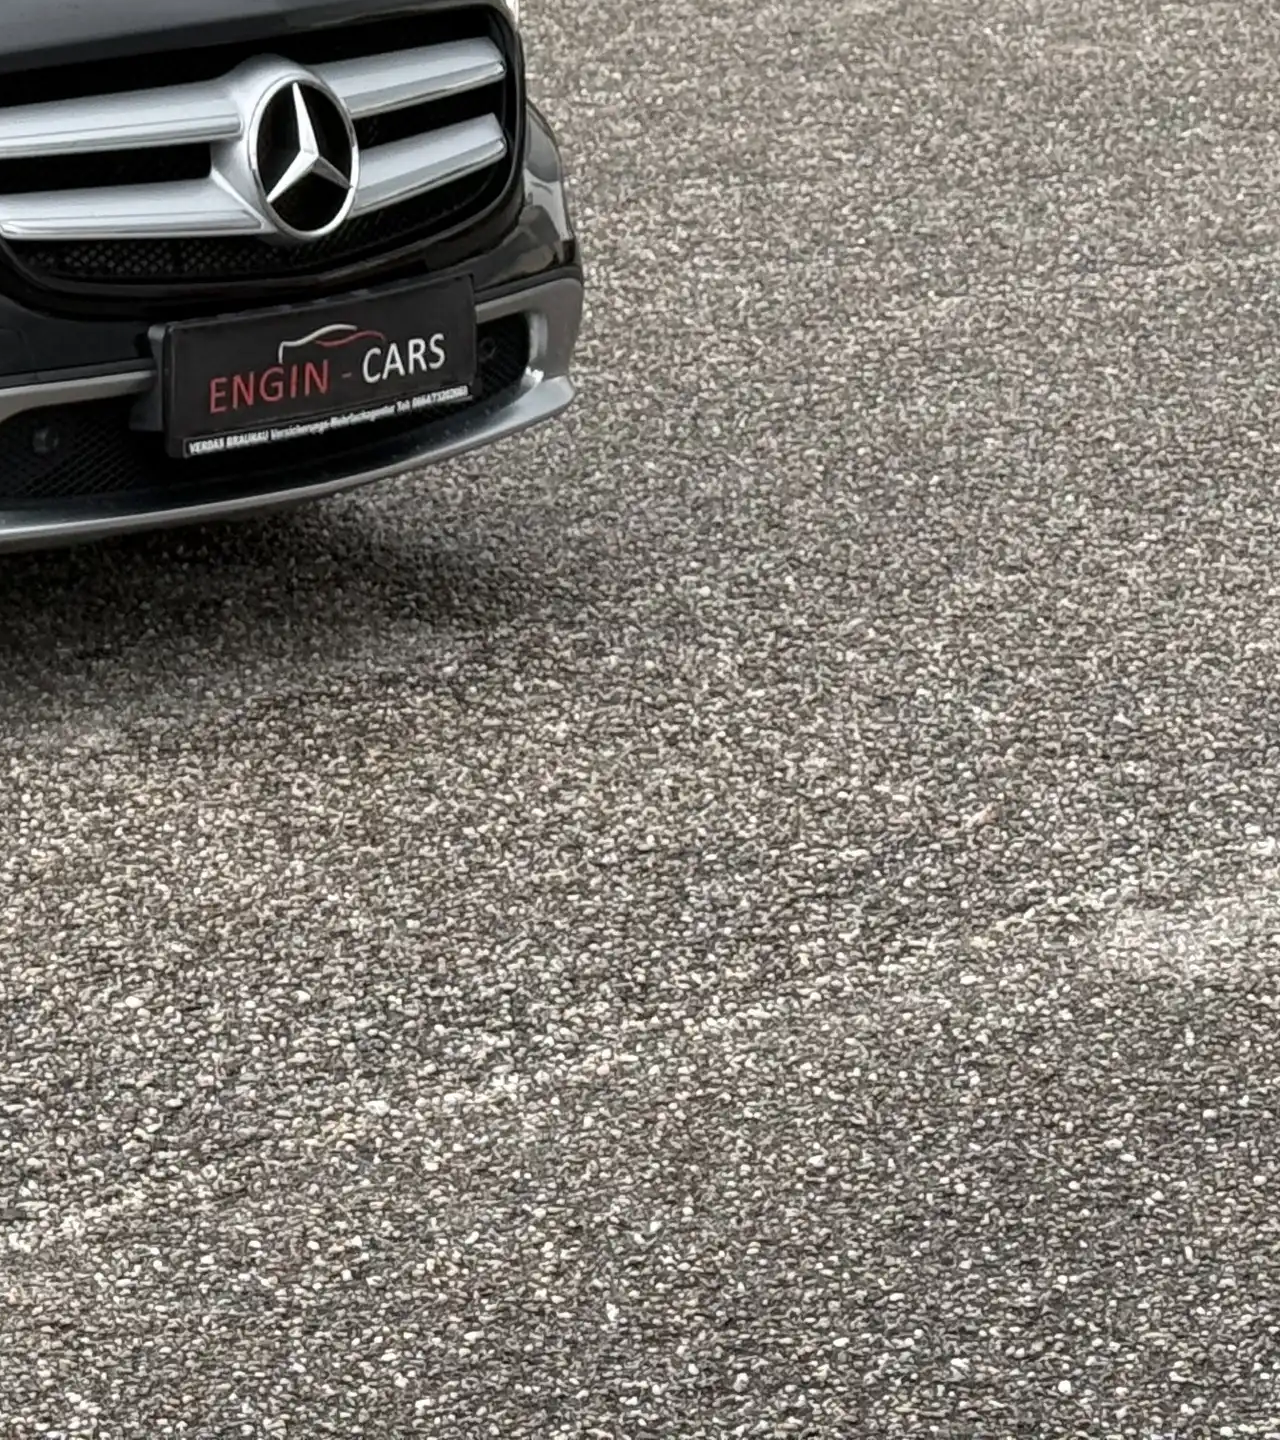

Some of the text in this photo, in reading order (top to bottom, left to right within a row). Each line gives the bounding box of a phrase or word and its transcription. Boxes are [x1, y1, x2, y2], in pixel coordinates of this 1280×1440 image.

[208, 358, 329, 415] ENGIN
[362, 332, 447, 385] CARS
[188, 436, 225, 457] VERDAS
